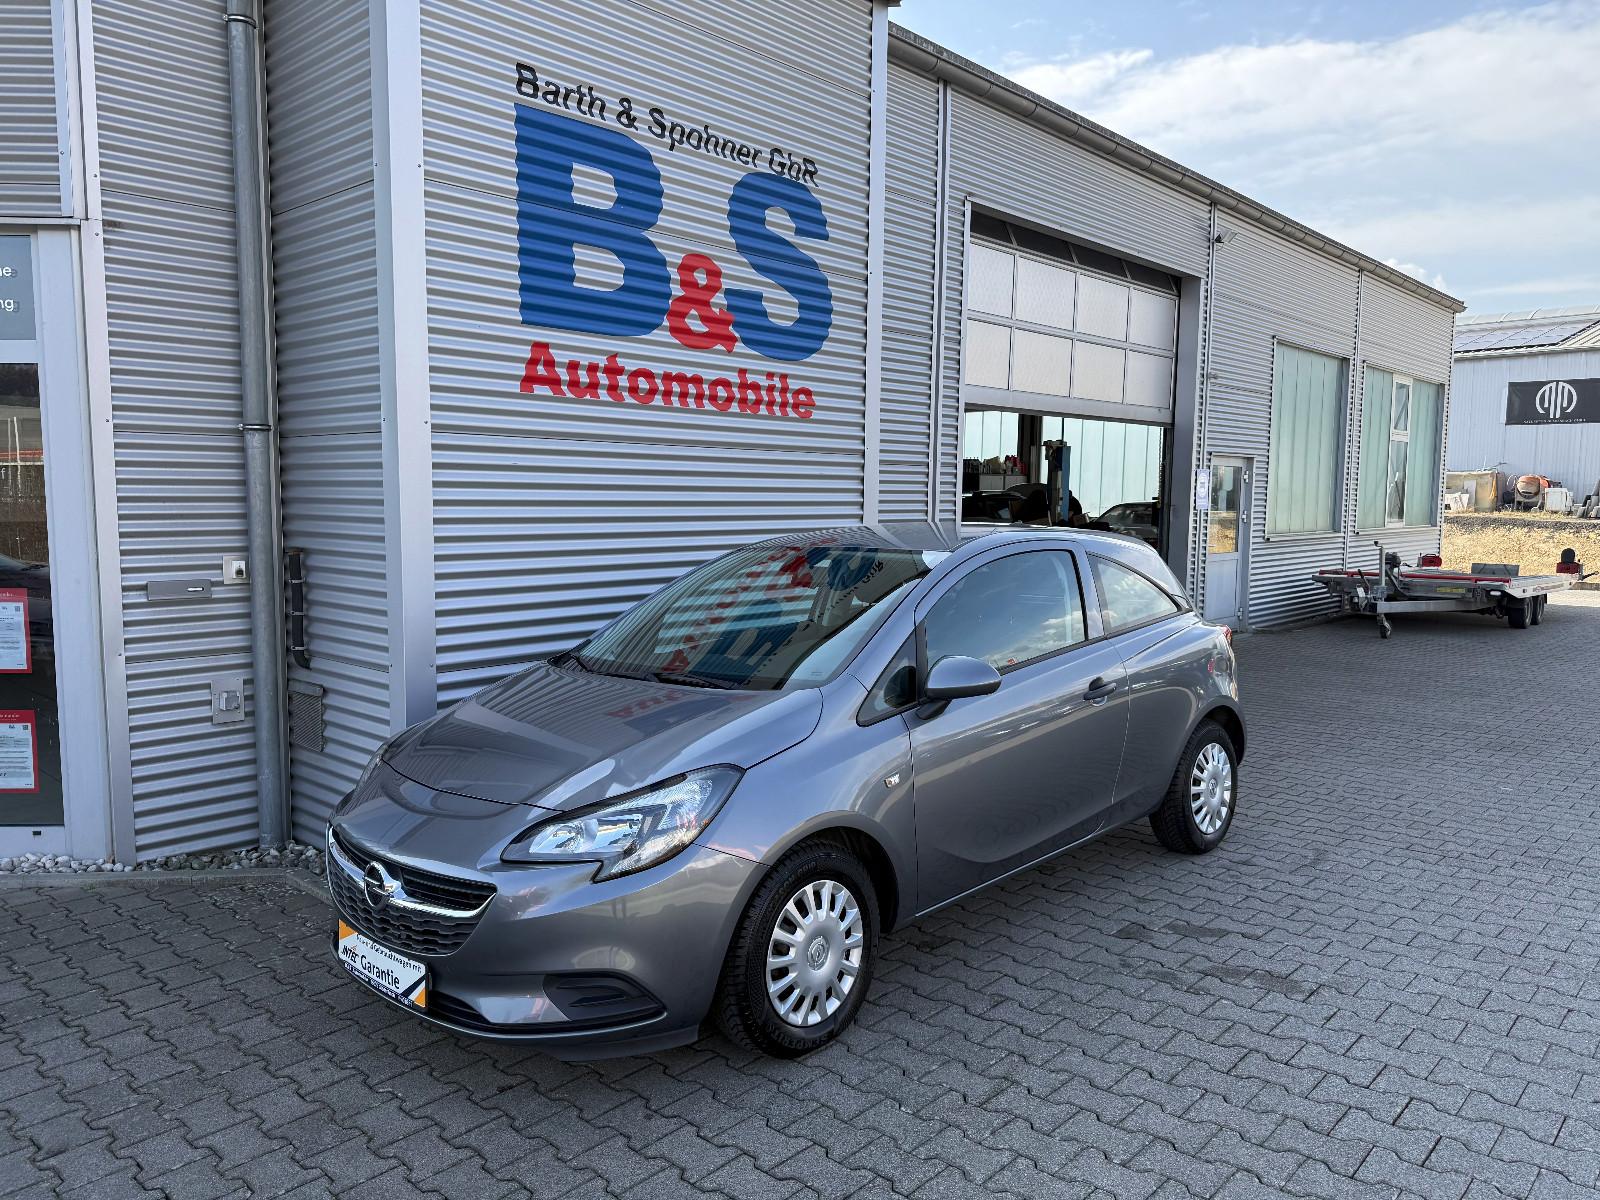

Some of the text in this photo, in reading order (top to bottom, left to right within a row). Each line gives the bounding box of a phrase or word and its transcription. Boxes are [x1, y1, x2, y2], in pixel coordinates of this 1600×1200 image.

[515, 62, 819, 187] Barth & Spohner GbR
[513, 102, 833, 361] B&S
[519, 341, 816, 419] Automobile
[360, 955, 400, 989] Garantie
